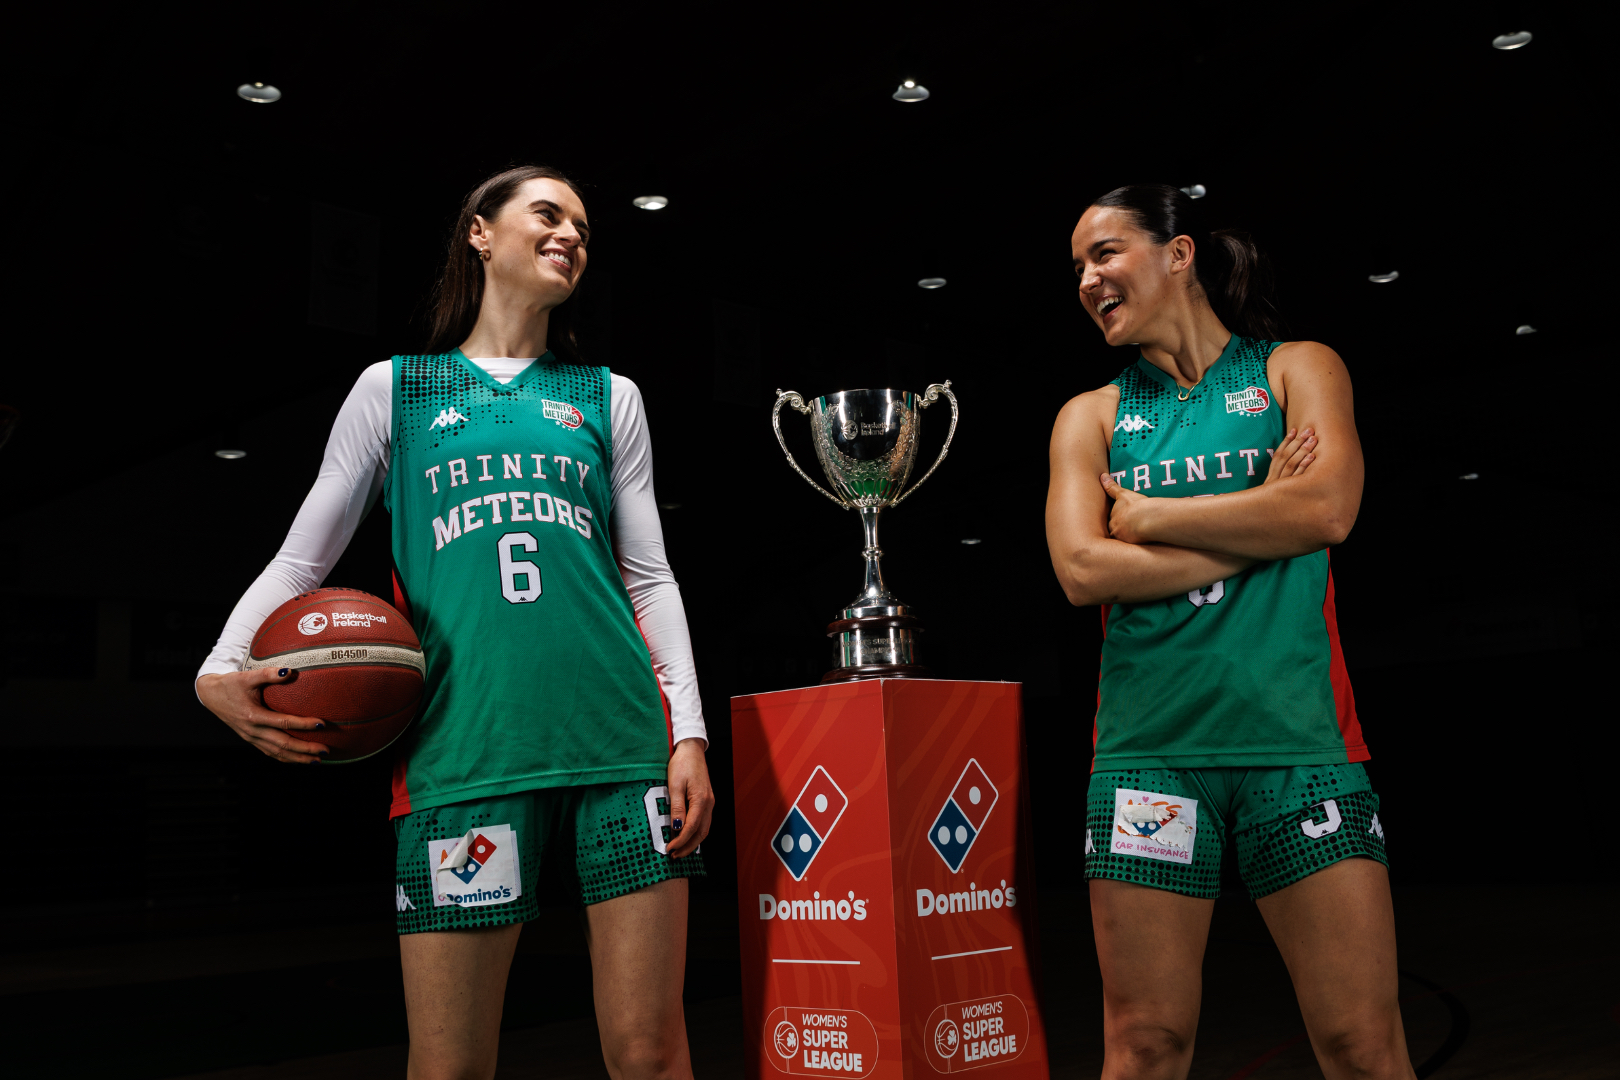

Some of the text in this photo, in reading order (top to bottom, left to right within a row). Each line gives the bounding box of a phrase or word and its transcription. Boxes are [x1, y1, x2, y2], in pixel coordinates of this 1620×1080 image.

[1226, 390, 1257, 402] TRINITY
[1227, 398, 1265, 411] METEORS
[543, 400, 571, 413] TRINITY
[544, 409, 578, 425] METEORS
[425, 454, 590, 494] TRINITY
[432, 491, 593, 551] METEORS
[497, 531, 543, 604] 6
[332, 611, 387, 624] Basketball
[333, 619, 371, 628] Ireland
[331, 649, 368, 660] BG4500
[1115, 841, 1189, 859] CAR INSURANCE
[758, 890, 868, 921] Domino's
[916, 879, 1017, 917] Domino's
[961, 1001, 1003, 1019] WOMEN'S
[802, 1013, 848, 1028] WOMEN'S
[962, 1016, 1005, 1040] SUPER
[802, 1028, 849, 1049] SUPER
[963, 1034, 1017, 1062] LEAGUE
[803, 1049, 863, 1072] LEAGUE
